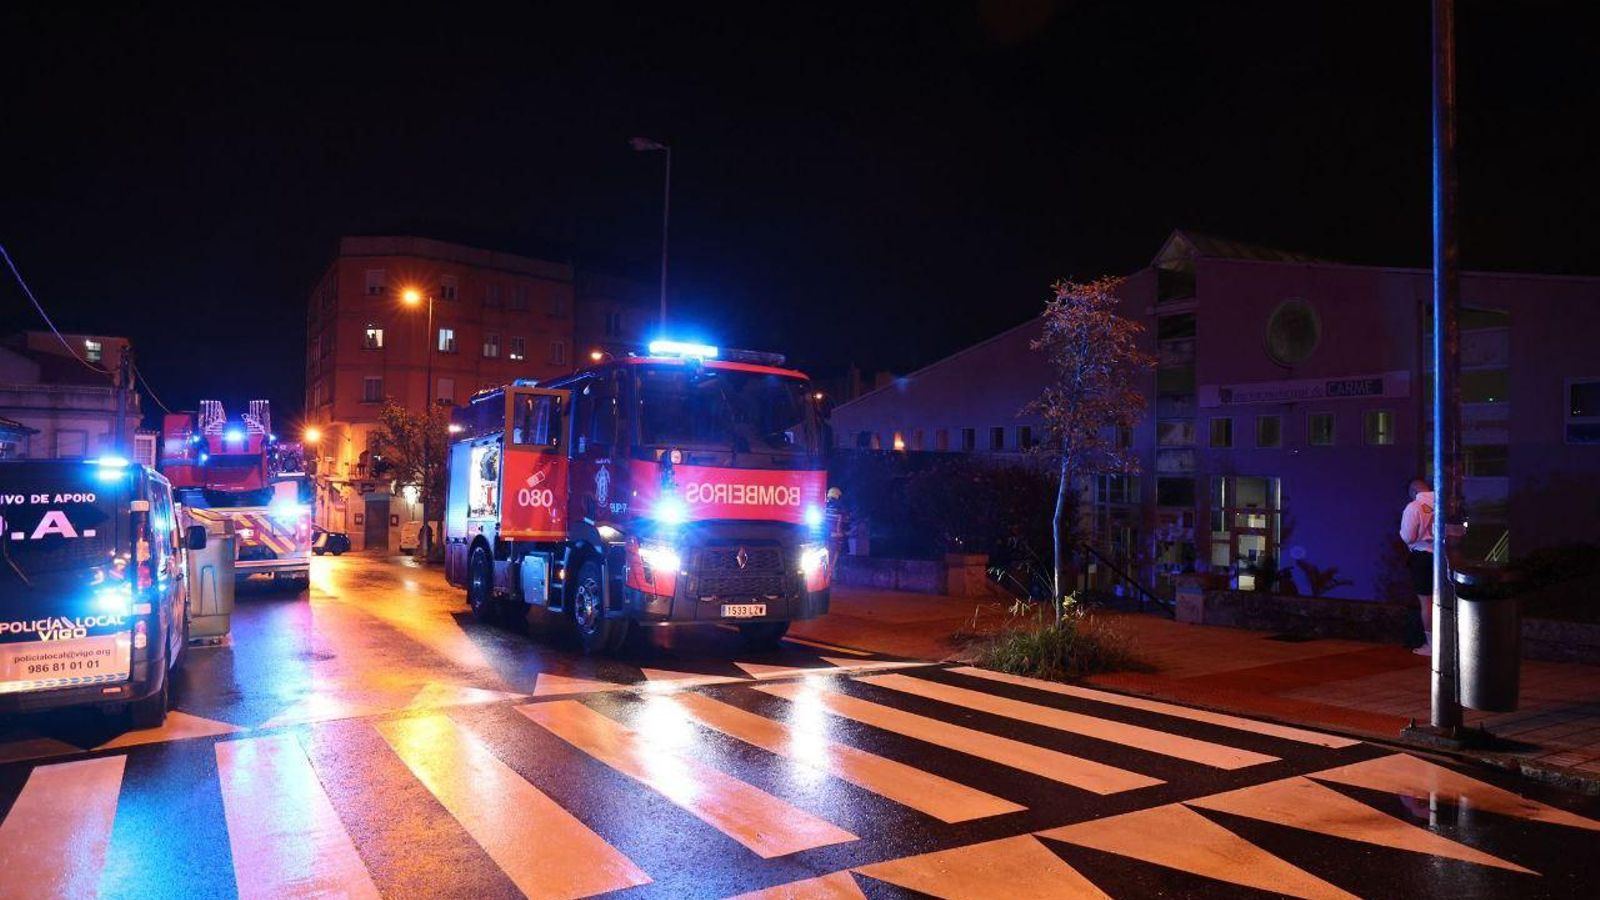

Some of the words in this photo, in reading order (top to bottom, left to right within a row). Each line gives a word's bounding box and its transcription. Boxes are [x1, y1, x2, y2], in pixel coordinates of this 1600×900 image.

[30, 494, 49, 504] DE
[54, 493, 96, 503] APOIO
[518, 488, 553, 507] 080
[75, 615, 126, 629] LOCAL
[38, 628, 87, 642] VIGO
[28, 663, 49, 674] 986
[52, 662, 65, 672] 81
[70, 661, 82, 670] 01
[86, 660, 100, 669] 01
